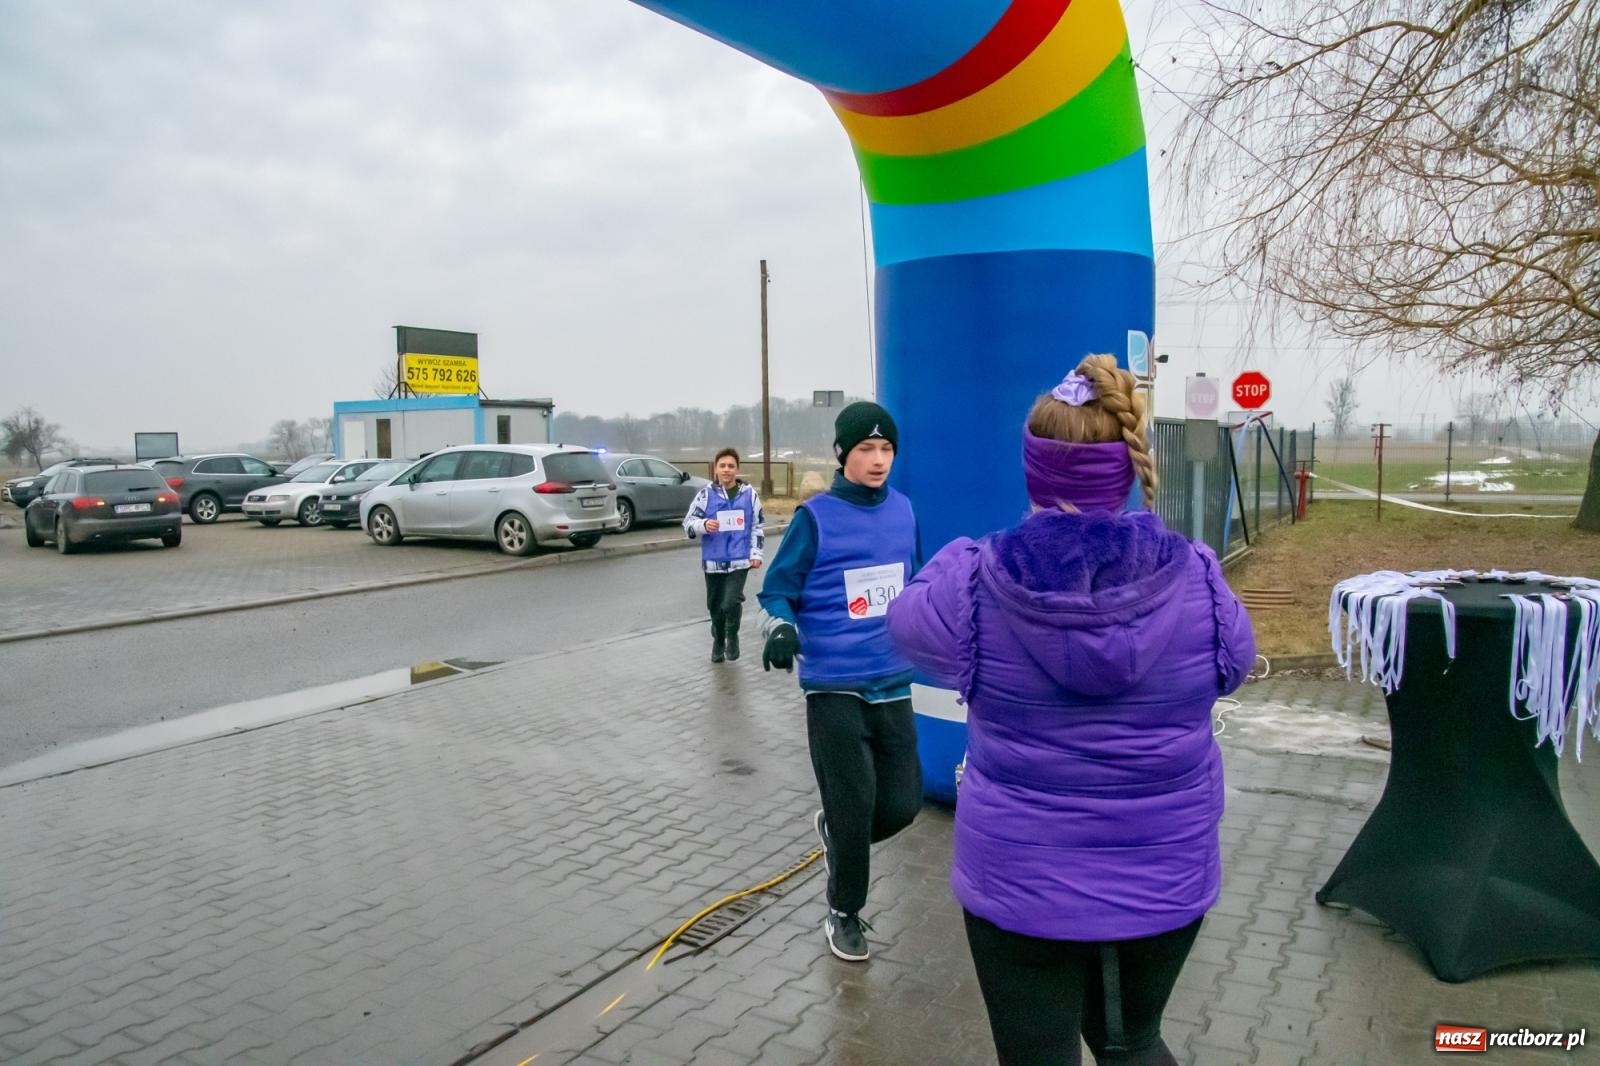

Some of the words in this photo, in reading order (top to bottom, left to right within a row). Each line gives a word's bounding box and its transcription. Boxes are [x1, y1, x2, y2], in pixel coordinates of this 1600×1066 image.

[442, 359, 467, 367] SZAMBA
[407, 366, 429, 381] 575
[432, 368, 453, 382] 792
[456, 369, 477, 383] 626
[1235, 383, 1268, 397] STOP
[864, 585, 896, 607] 130
